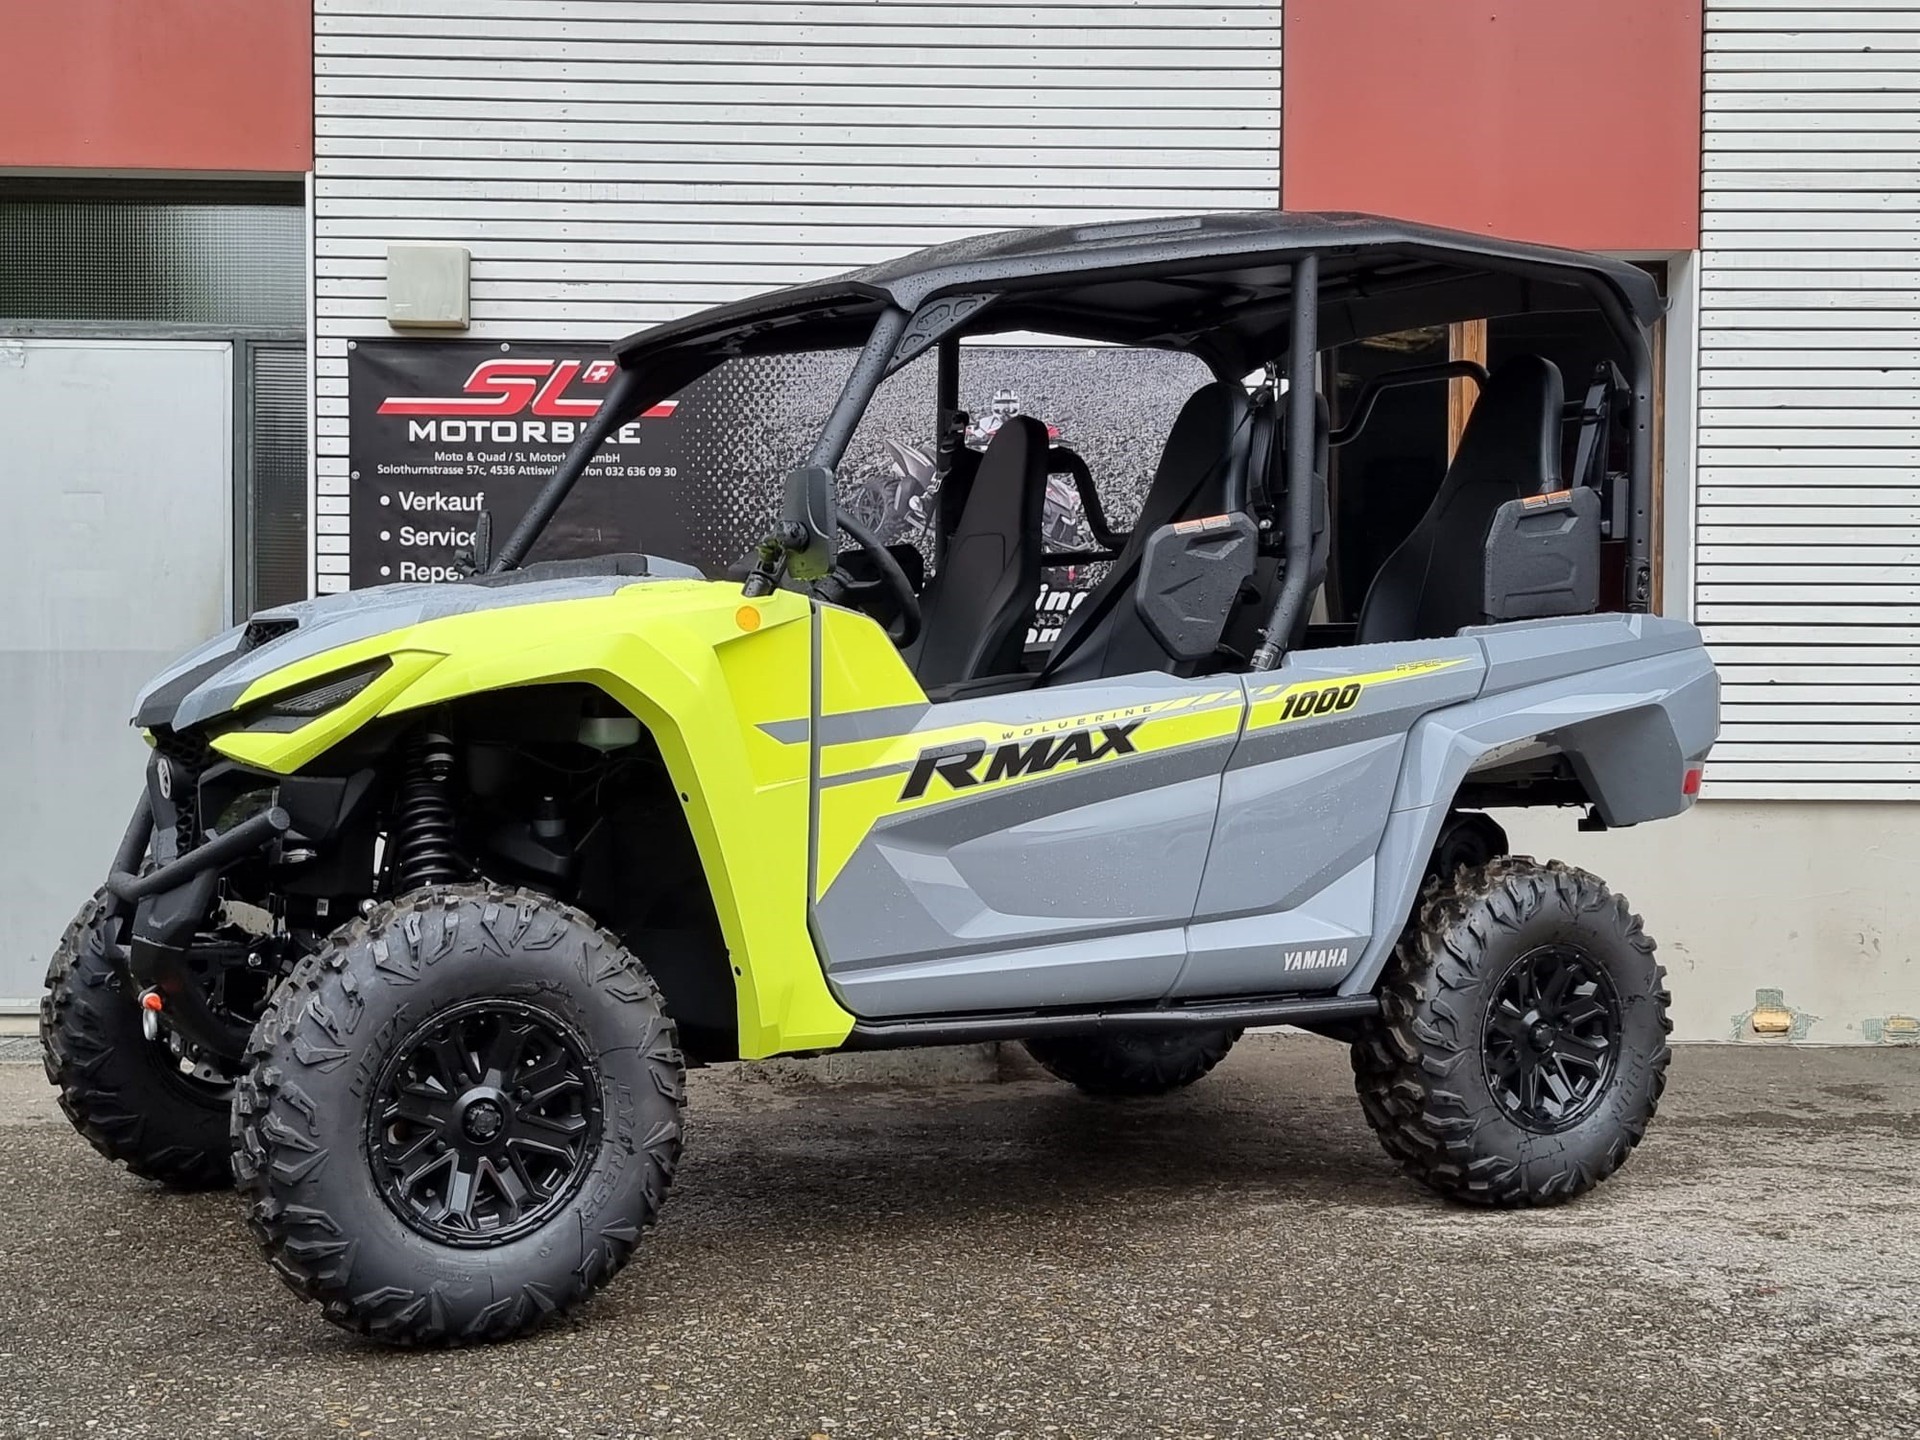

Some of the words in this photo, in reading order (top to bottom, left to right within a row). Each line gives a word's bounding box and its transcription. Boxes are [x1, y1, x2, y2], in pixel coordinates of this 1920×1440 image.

[408, 420, 641, 444] MOTORBE
[434, 451, 464, 462] Moto
[466, 451, 475, 462] &
[477, 451, 506, 463] Quad
[515, 452, 527, 462] SL
[377, 463, 464, 475] Solothurnstrasse
[466, 464, 487, 476] 57c,
[489, 464, 516, 476] 4536
[605, 466, 625, 477] 032
[627, 466, 646, 477] 636
[648, 466, 662, 478] 09
[663, 466, 677, 477] 30
[398, 491, 485, 511] Verkauf
[1279, 682, 1362, 721] 1000
[898, 716, 1148, 802] RMAX
[1284, 948, 1348, 971] YAMAHA
